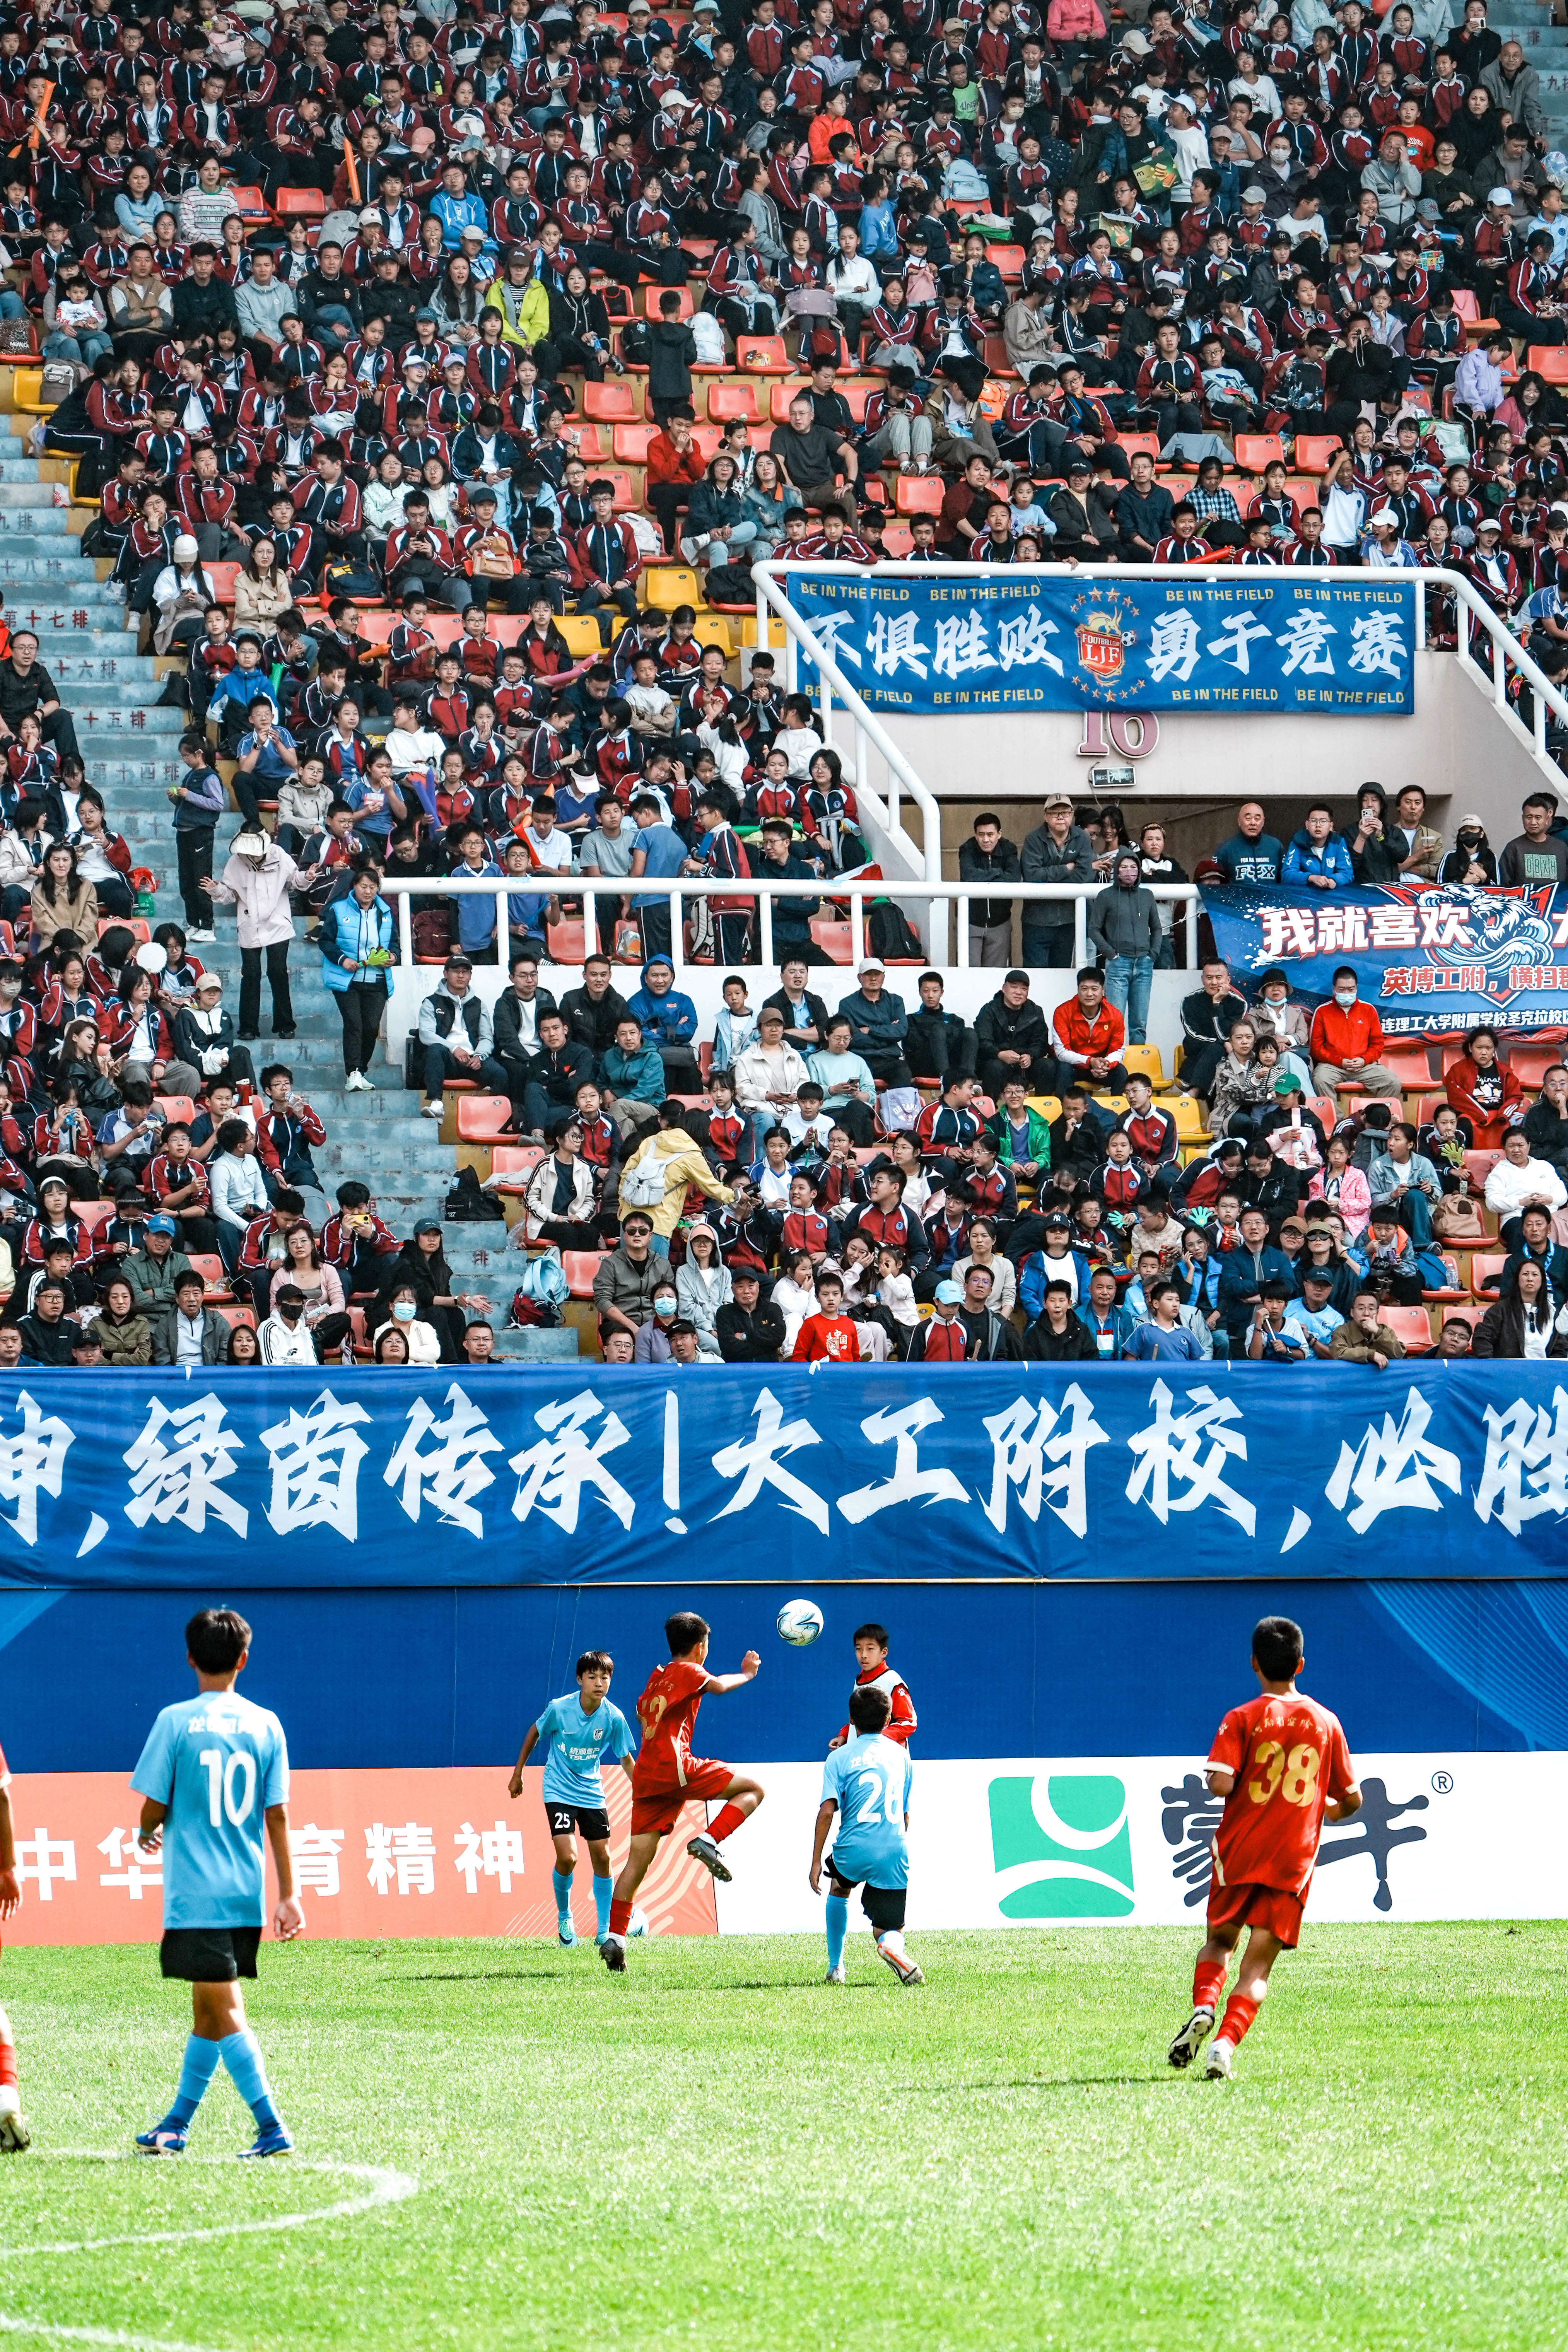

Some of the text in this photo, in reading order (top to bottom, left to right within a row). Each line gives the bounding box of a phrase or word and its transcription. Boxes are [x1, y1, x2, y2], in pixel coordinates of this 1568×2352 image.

[801, 582, 910, 601] BE IN THE FIELD
[930, 584, 1040, 601] BE IN THE FIELD
[1166, 588, 1274, 601] BE IN THE FIELD
[1294, 588, 1403, 603] BE IN THE FIELD
[802, 603, 1064, 680] 不惧胜败
[1082, 634, 1113, 646] FOOTBALL
[1145, 607, 1408, 683] 勇于竞赛
[1085, 644, 1120, 664] LJF
[40, 659, 116, 678] 十六排
[876, 689, 912, 704] FIELD
[933, 688, 1044, 704] BE IN THE FIELD
[1172, 688, 1278, 700] BE IN THE FIELD
[1297, 688, 1404, 704] BE IN THE FIELD
[70, 710, 146, 729] 十五排
[1262, 904, 1474, 957] 我就喜欢
[833, 1330, 847, 1345] 中国
[1248, 1741, 1320, 1807] 38
[199, 1749, 257, 1828] 10
[554, 1812, 571, 1829] 25
[15, 1821, 525, 1901] 中华育精神
